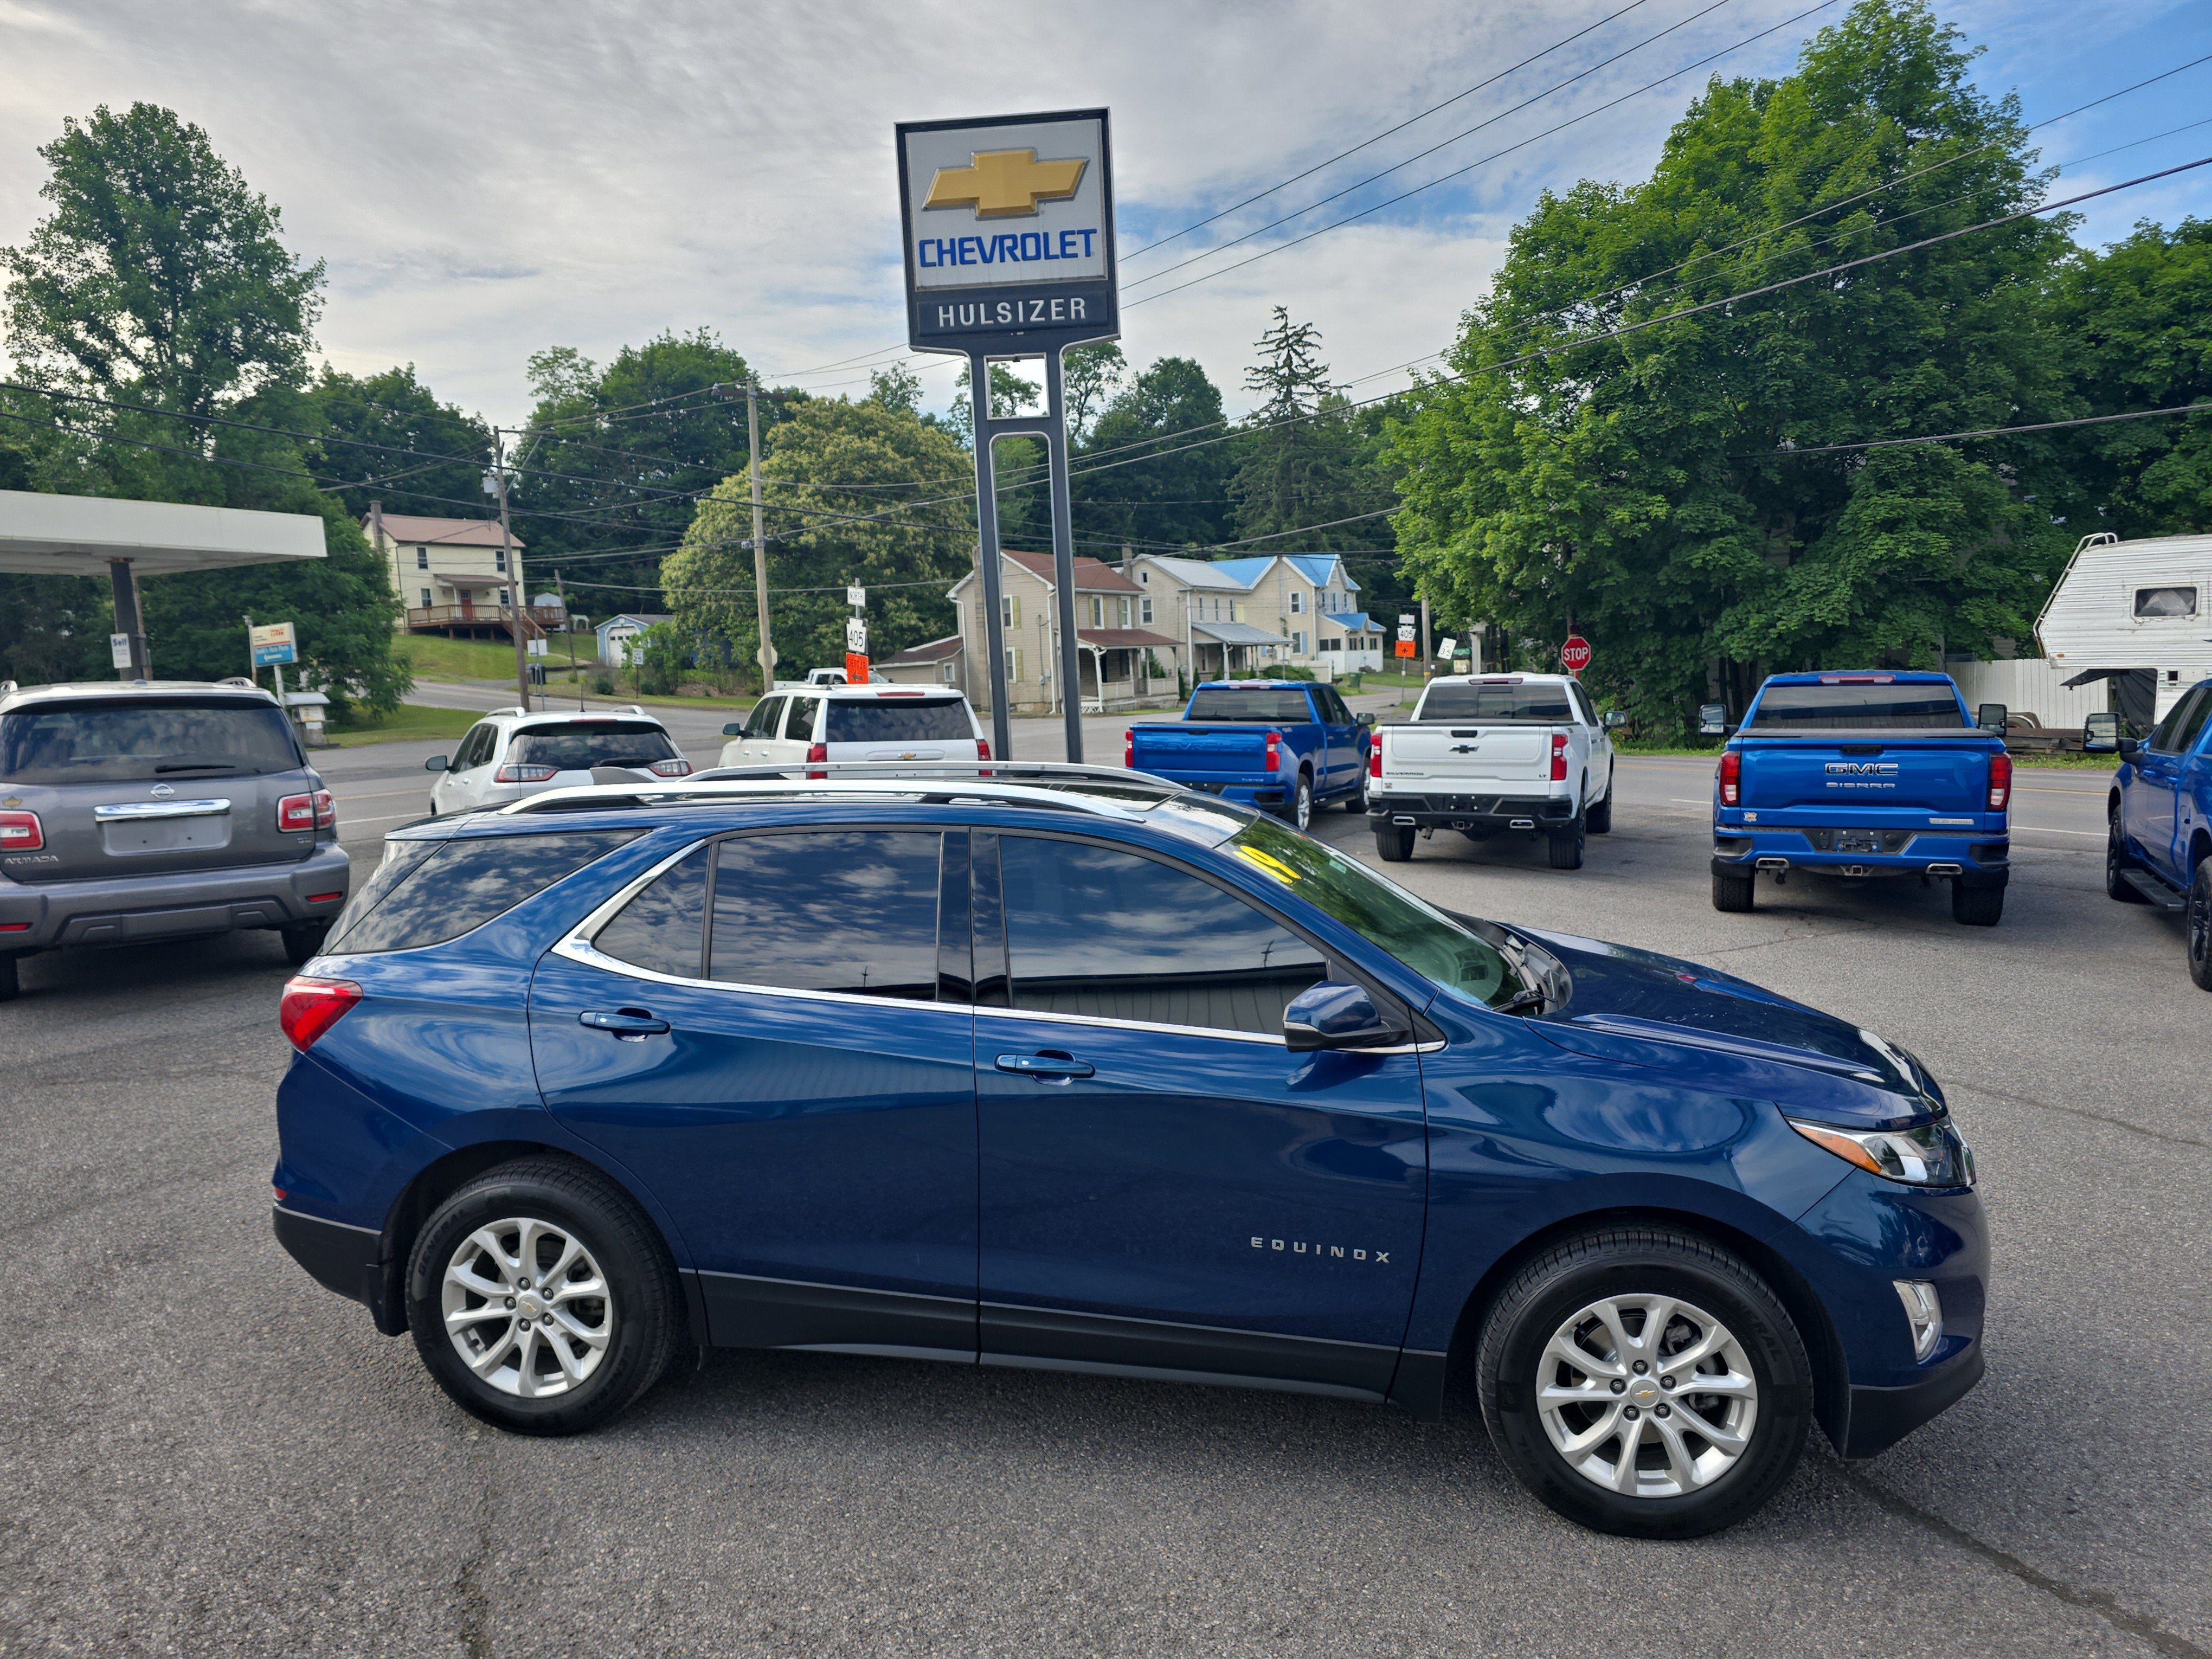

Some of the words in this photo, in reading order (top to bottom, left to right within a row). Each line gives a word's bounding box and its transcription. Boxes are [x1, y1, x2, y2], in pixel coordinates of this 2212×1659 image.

[919, 229, 1097, 267] CHEVROLET
[939, 298, 1086, 328] HULSIZER
[849, 589, 863, 601] NORTH
[849, 629, 864, 647] 405
[1400, 630, 1413, 638] 405
[1564, 647, 1589, 661] STOP
[848, 658, 866, 670] DETOUR
[1825, 762, 1899, 776] GMC
[4, 855, 60, 865] ARMADA
[1251, 1237, 1390, 1263] EQUINOX
